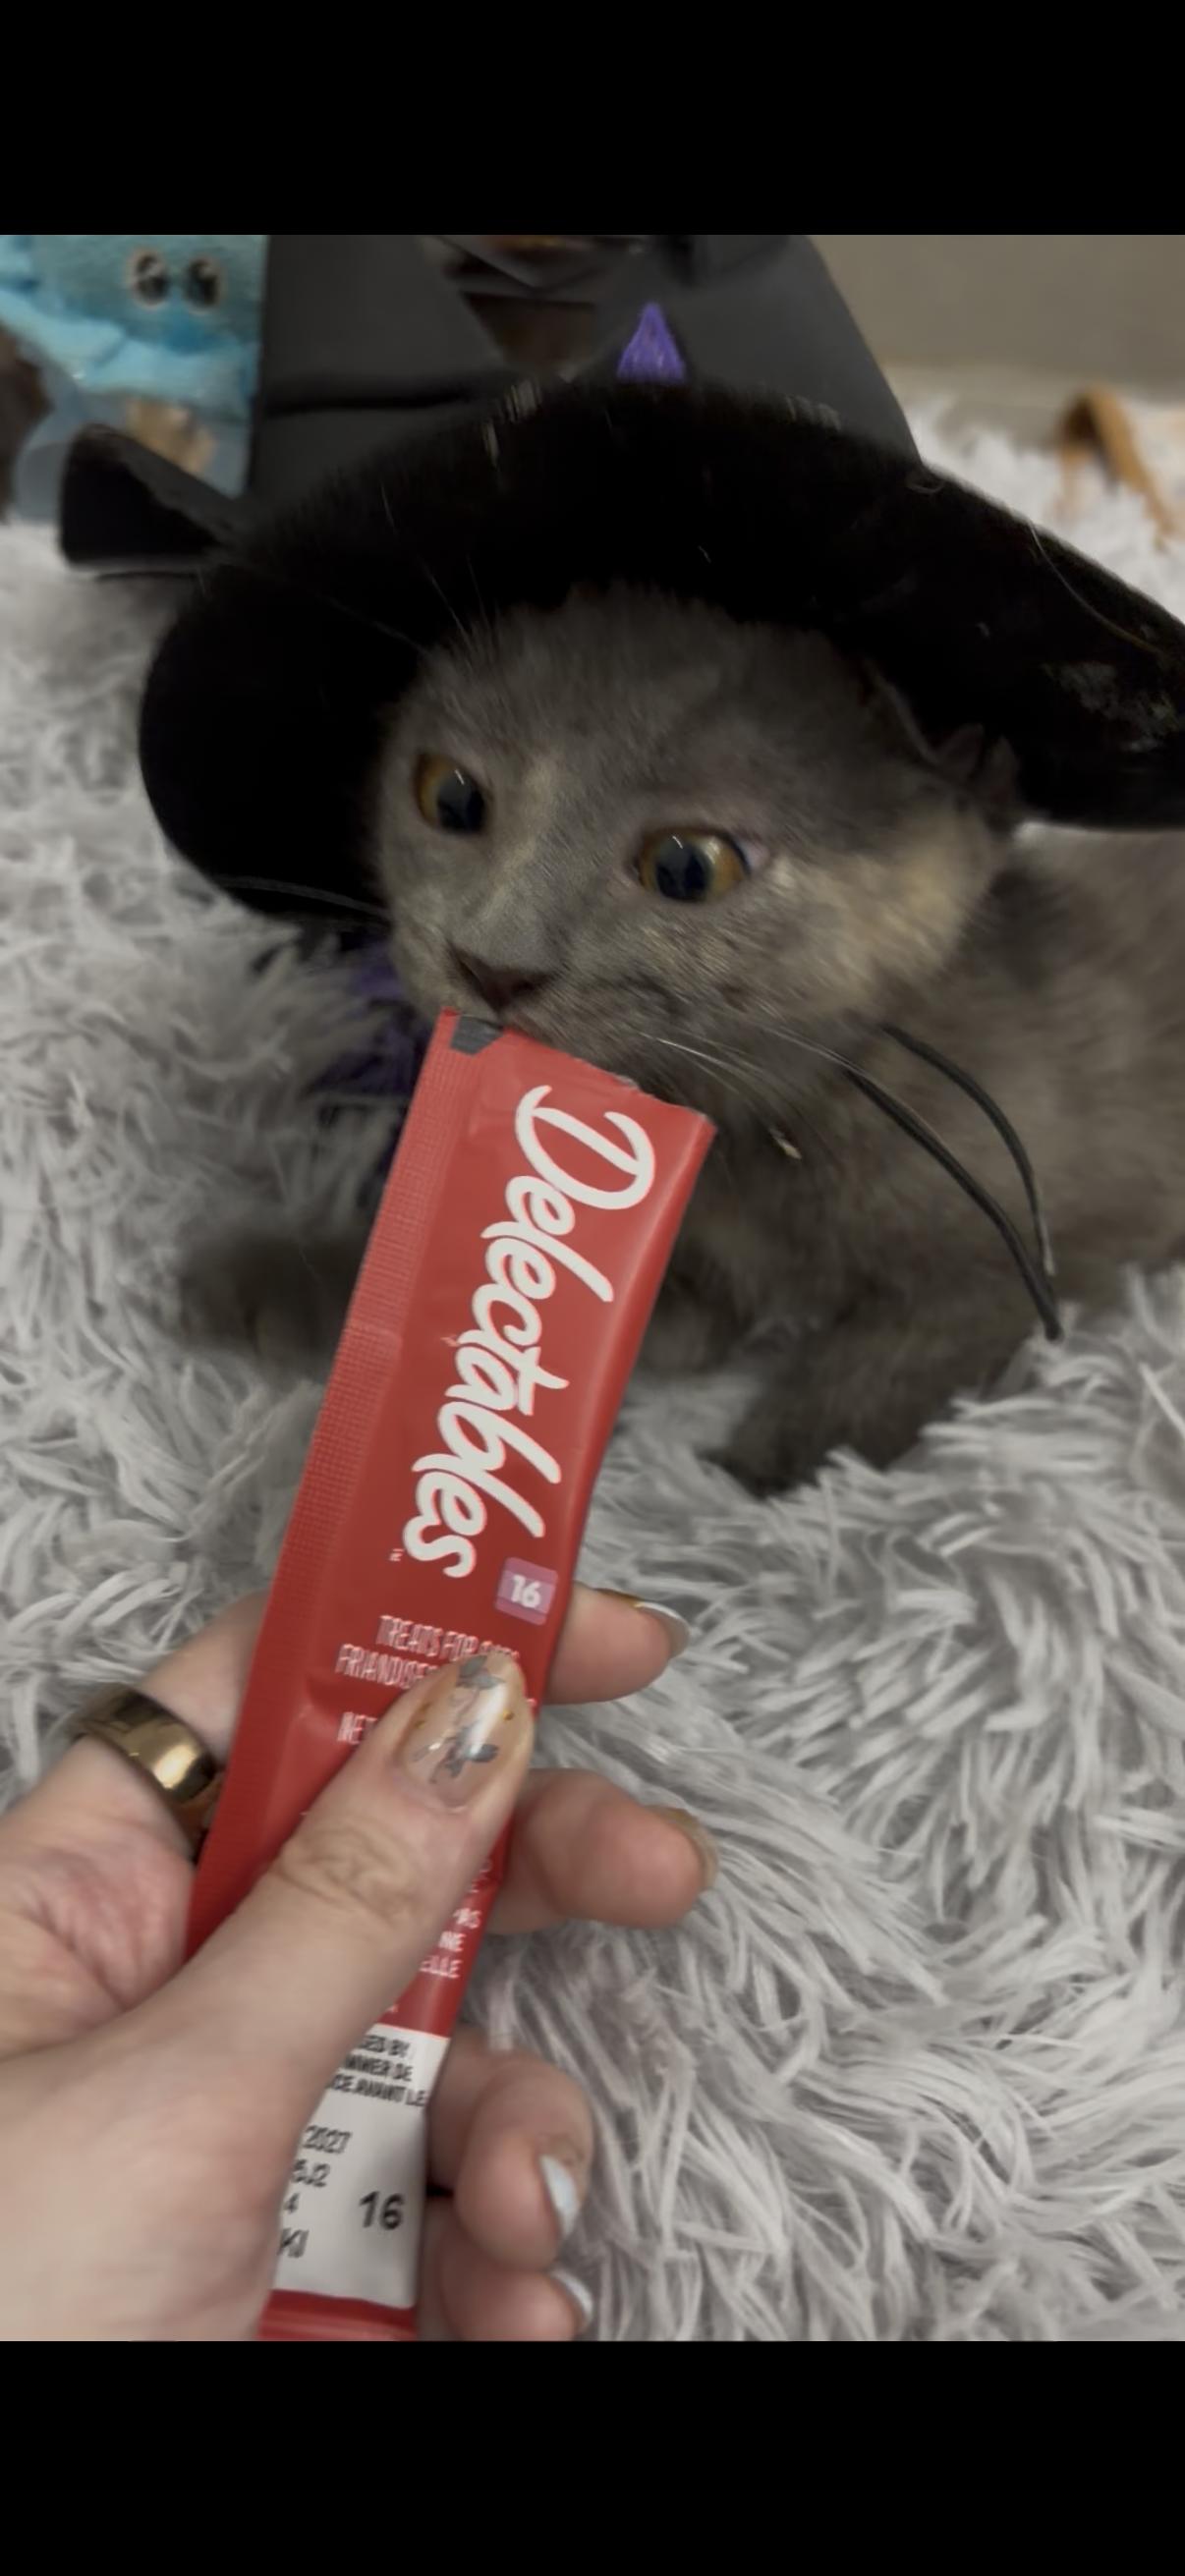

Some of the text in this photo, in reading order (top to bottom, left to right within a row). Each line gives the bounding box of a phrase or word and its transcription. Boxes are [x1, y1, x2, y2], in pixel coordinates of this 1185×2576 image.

[402, 1084, 655, 1578] Delectables
[510, 1574, 541, 1609] 16
[375, 1614, 443, 1657] TREATS
[334, 1643, 440, 1690] FRIANDISE
[388, 2040, 411, 2058] BY
[405, 2089, 426, 2107] LE
[302, 2125, 353, 2155] 2027
[359, 2190, 406, 2231] 16
